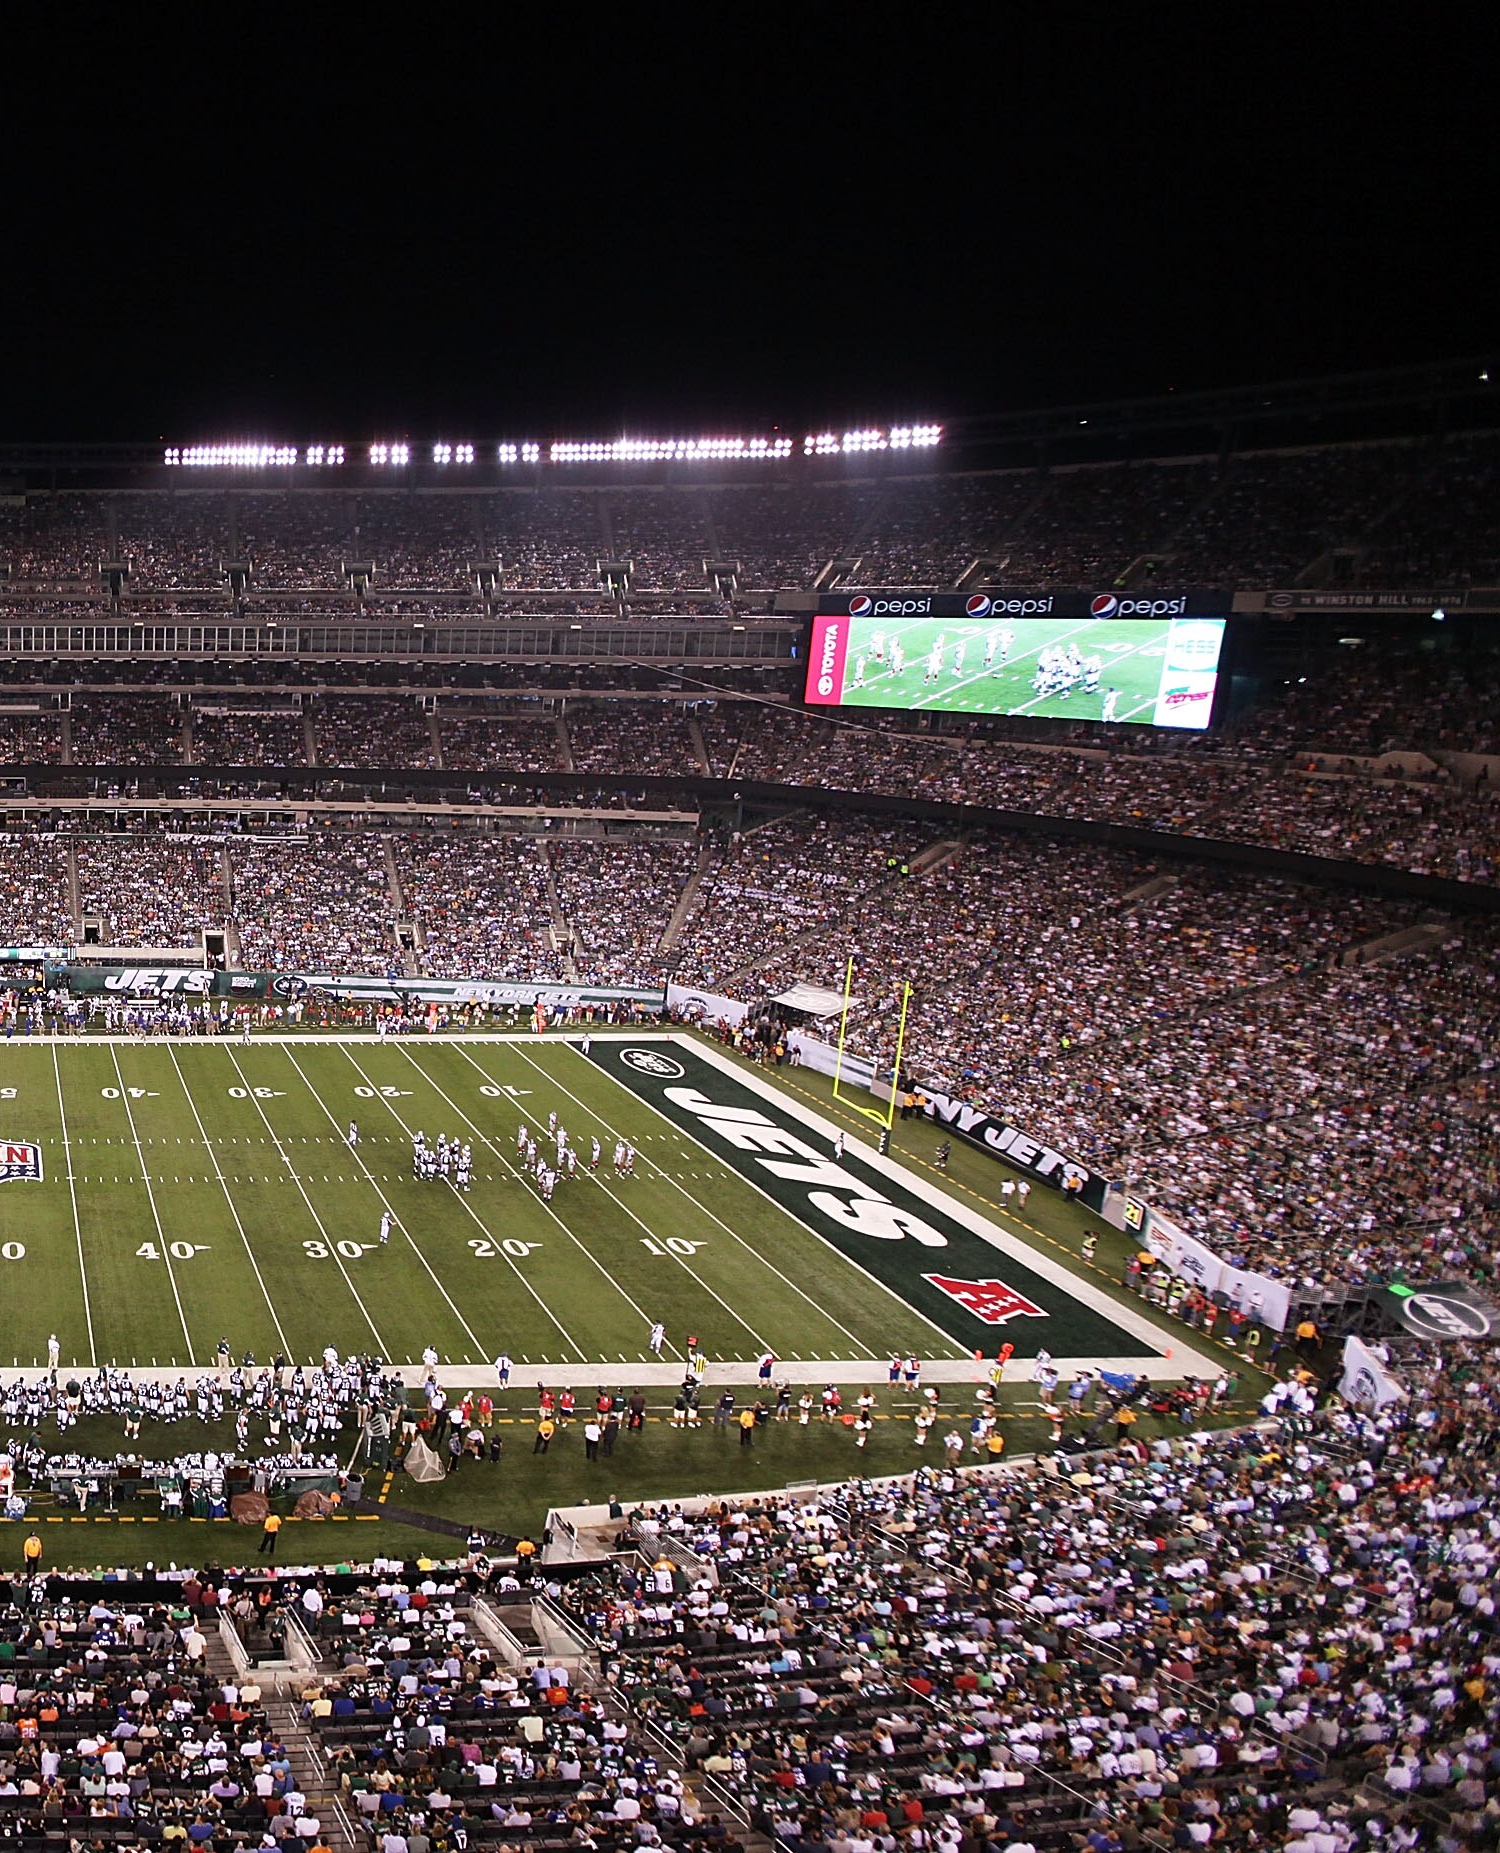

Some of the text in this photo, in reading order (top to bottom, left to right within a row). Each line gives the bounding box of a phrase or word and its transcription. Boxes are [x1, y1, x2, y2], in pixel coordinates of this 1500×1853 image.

[874, 597, 932, 616] pepsi
[991, 596, 1054, 616] pepsi
[1117, 596, 1187, 618] pepsi
[1315, 595, 1373, 605] WINSTON
[1379, 595, 1408, 605] HILL
[820, 624, 839, 675] TOYOTA
[104, 969, 214, 992] JETS
[453, 987, 582, 1001] NEW YORK JETS
[101, 1087, 149, 1098] 40
[228, 1087, 276, 1098] 30
[355, 1086, 403, 1097] 20
[479, 1085, 521, 1096] 10
[924, 1092, 1090, 1193] NY JETS
[663, 1086, 948, 1247] JETS
[1124, 1202, 1140, 1226] 21
[135, 1240, 197, 1260] 40
[301, 1239, 365, 1260] 30
[467, 1238, 530, 1258] 20
[638, 1236, 695, 1256] 10
[1413, 1296, 1480, 1337] JETS
[31, 1590, 43, 1602] 73
[645, 1581, 655, 1592] 51
[291, 1804, 304, 1816] 12
